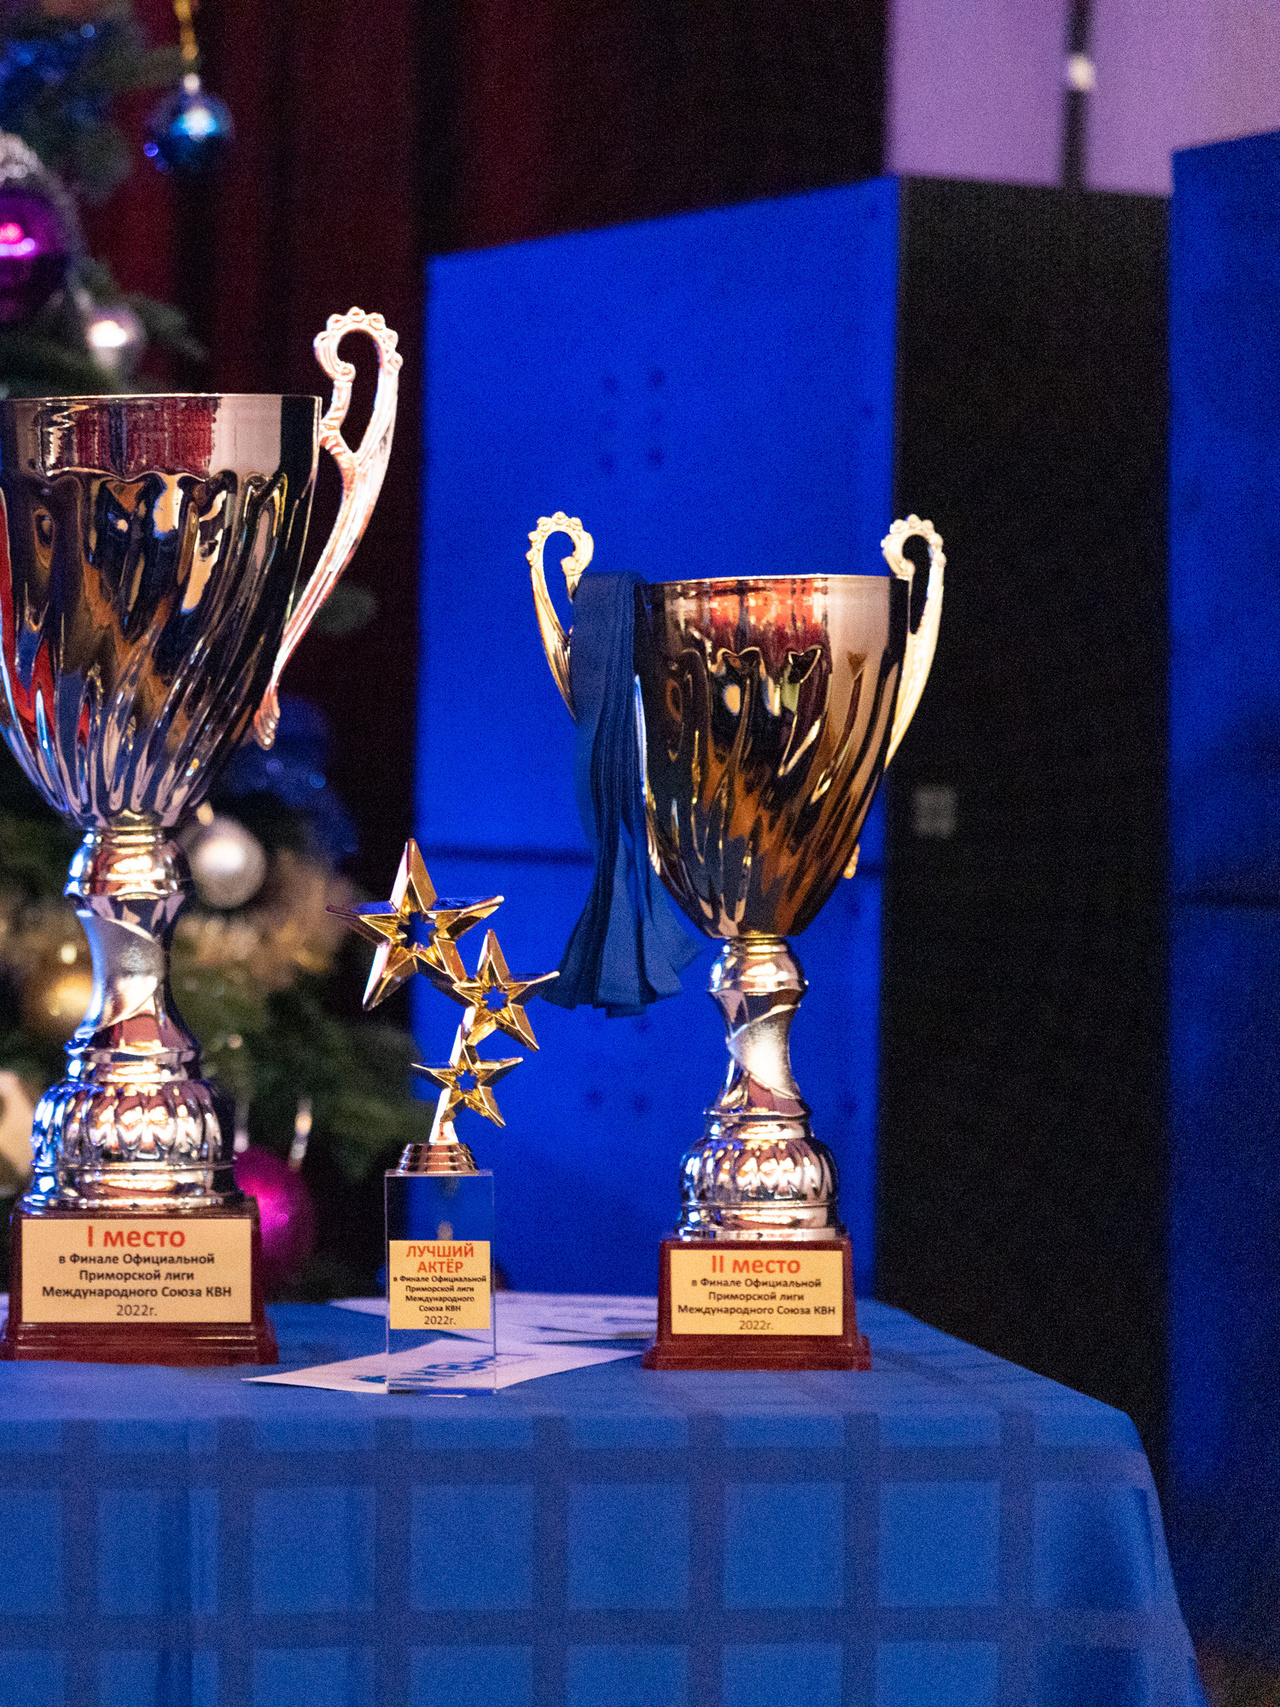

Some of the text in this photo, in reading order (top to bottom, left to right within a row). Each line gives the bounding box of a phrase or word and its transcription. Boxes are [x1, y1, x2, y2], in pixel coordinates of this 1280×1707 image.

[103, 1230, 186, 1248] место
[406, 1243, 474, 1257] ЛУЧШИЙ
[69, 1254, 119, 1264] Финале
[123, 1254, 215, 1266] Официальной
[417, 1259, 463, 1273] АКТЁР
[732, 1259, 801, 1274] место
[79, 1270, 194, 1282] Приморской лиги
[700, 1278, 742, 1287] Финале
[745, 1278, 821, 1288] Официальной
[43, 1286, 231, 1300] Международного Союза КВН
[406, 1285, 454, 1293] Приморской
[708, 1292, 776, 1301] Приморской
[116, 1305, 157, 1316] 2022г.
[678, 1305, 835, 1315] Международного Союза КВН
[424, 1316, 456, 1325] 2022г.
[739, 1321, 773, 1330] 2022г.
